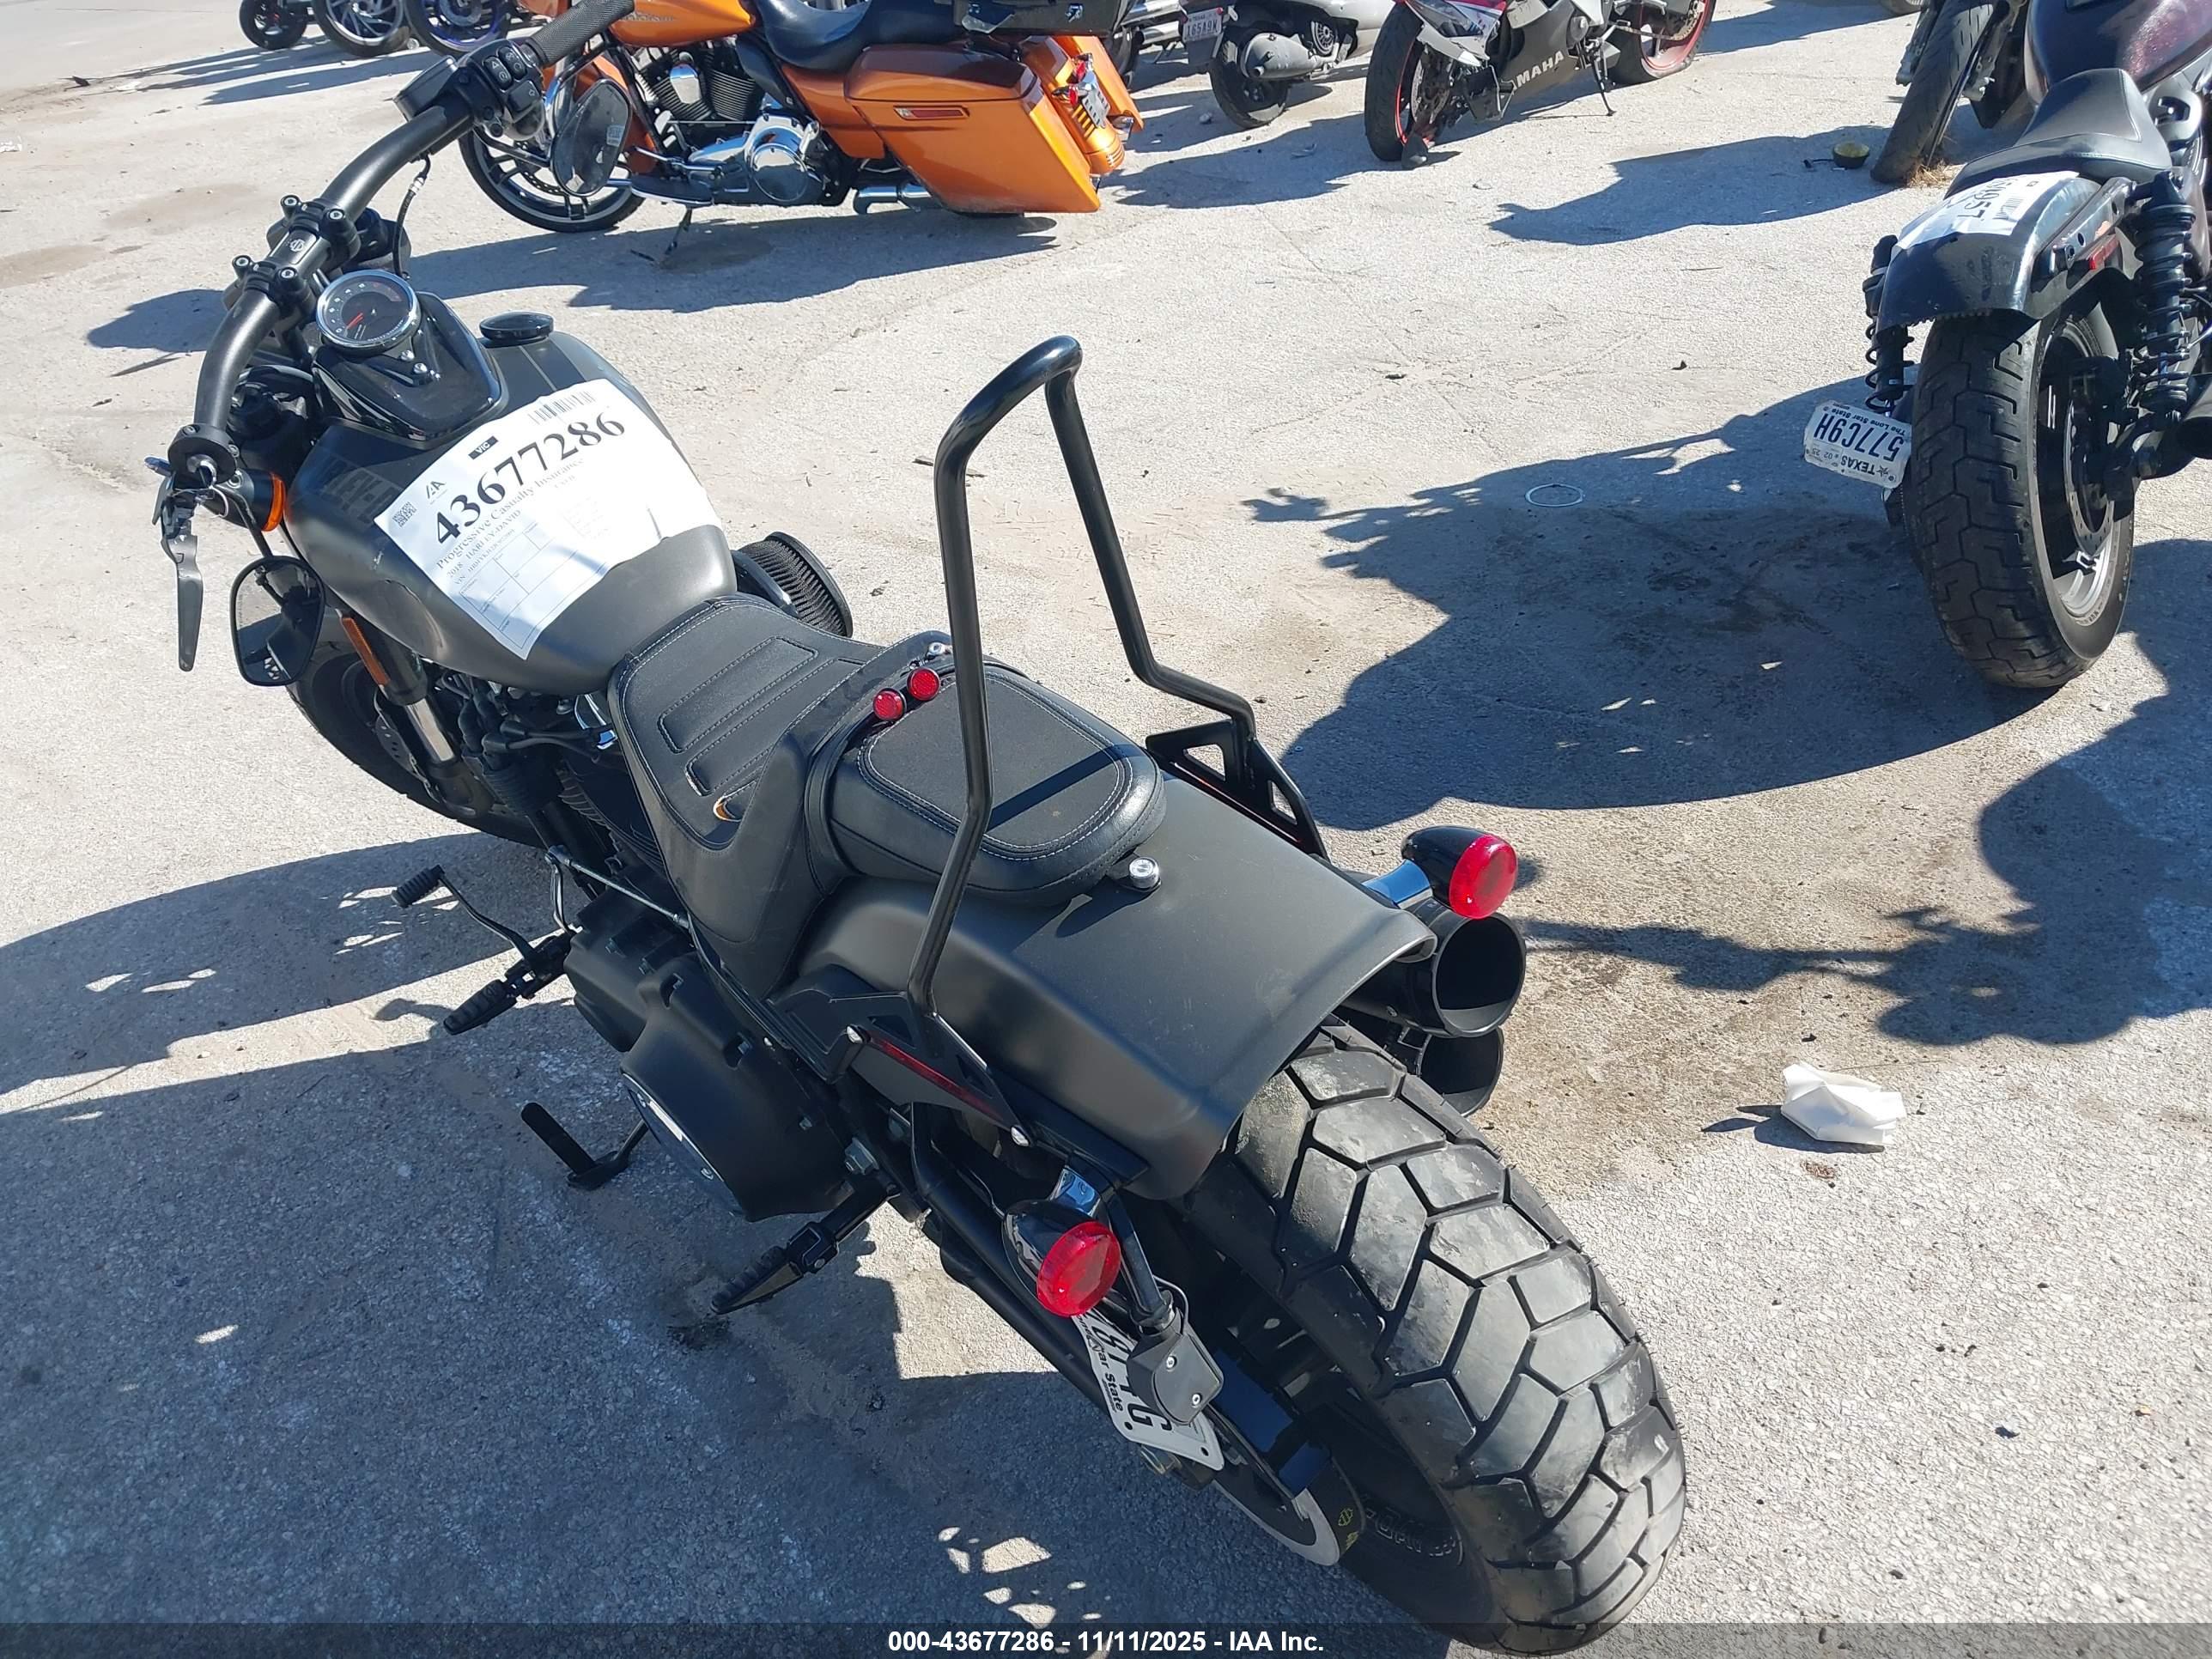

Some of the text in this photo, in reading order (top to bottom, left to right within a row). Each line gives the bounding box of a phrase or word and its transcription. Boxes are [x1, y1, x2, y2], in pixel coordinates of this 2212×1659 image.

[1514, 51, 1565, 90] MAHA
[1814, 413, 1905, 462] 577C9H
[1832, 408, 1905, 436] The Lone Star State
[476, 441, 492, 455] VIC
[1840, 455, 1875, 475] TEXAS
[436, 411, 625, 544] 43677286
[436, 516, 492, 569] Progressive
[490, 484, 534, 520] Casualty
[536, 458, 585, 489] Insurance
[447, 562, 465, 578] 2018
[1104, 1372, 1124, 1412] State
